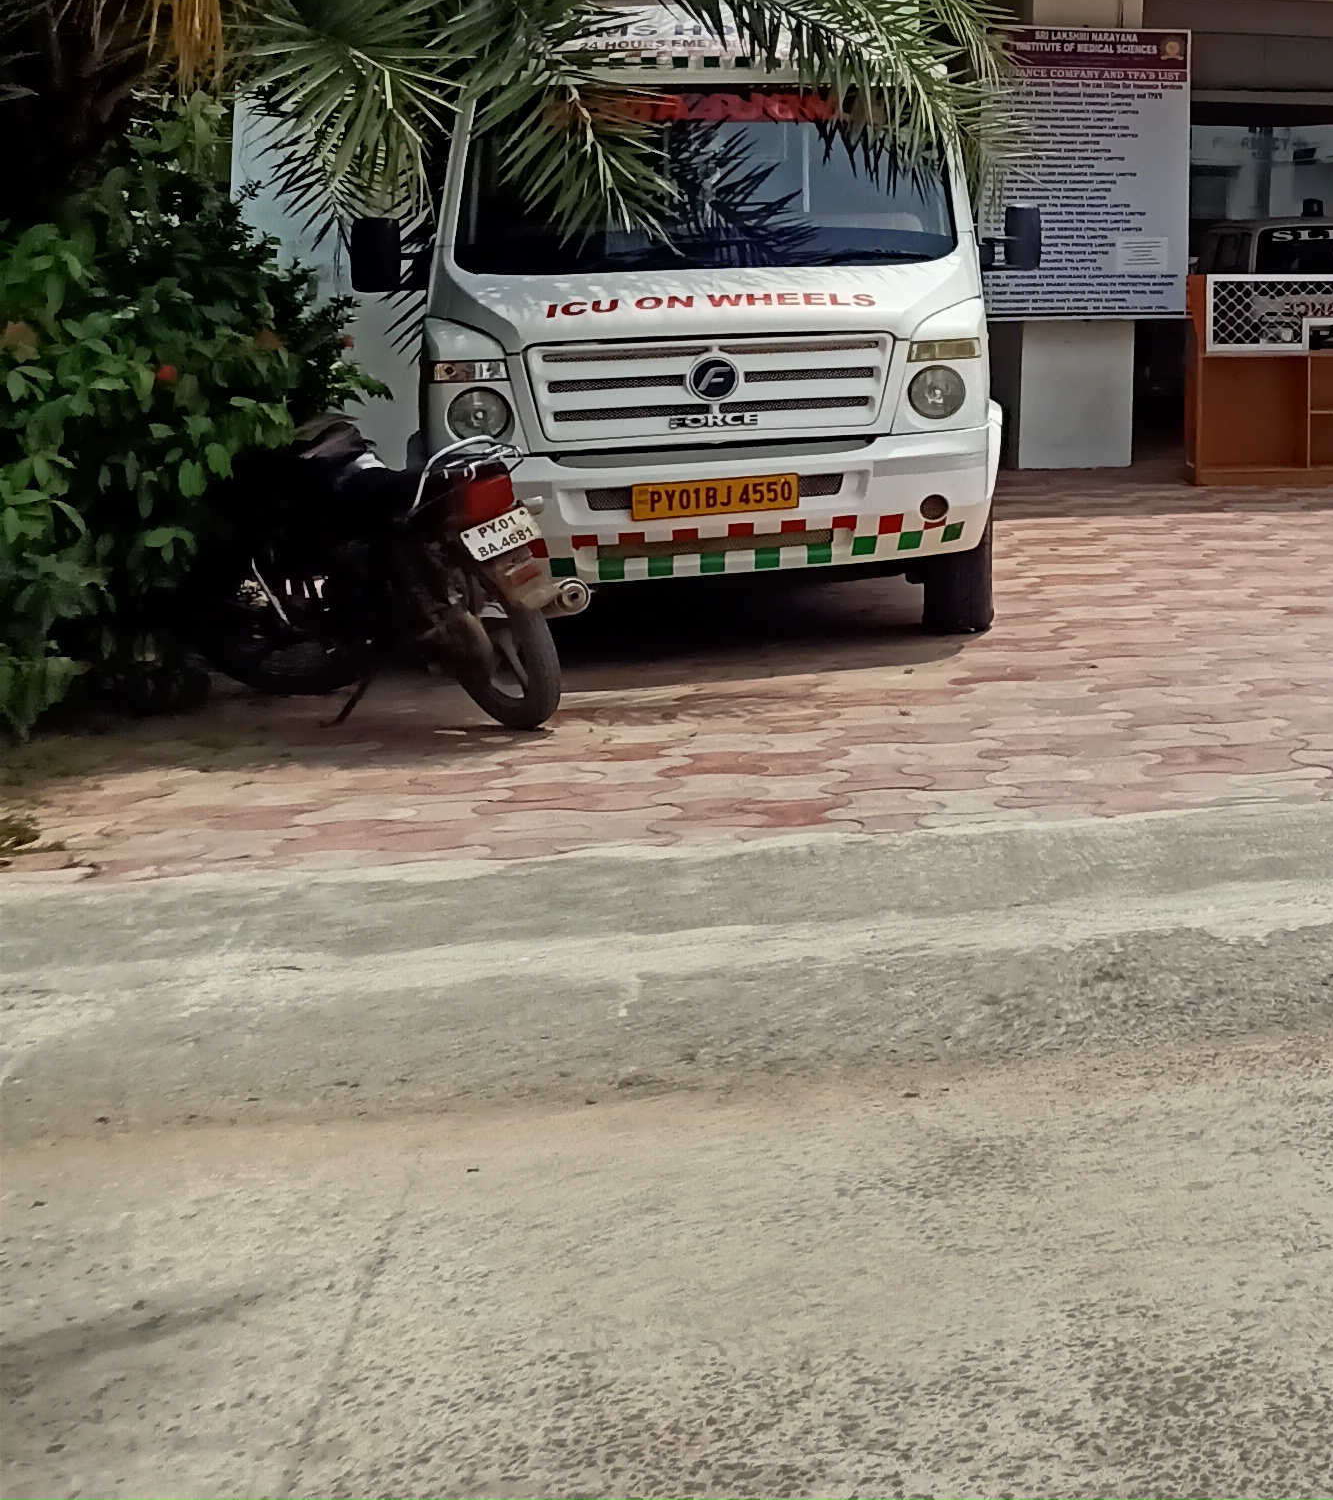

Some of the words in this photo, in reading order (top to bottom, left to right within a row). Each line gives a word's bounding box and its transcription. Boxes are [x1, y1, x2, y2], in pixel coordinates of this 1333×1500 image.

[1050, 69, 1100, 79] COMPANY
[1102, 70, 1126, 79] AND
[546, 299, 621, 319] ICU
[636, 294, 694, 311] ON
[707, 292, 877, 309] WHEELS
[669, 411, 760, 429] FORCE
[648, 484, 735, 513] PY01BJ
[738, 479, 792, 504] 4550
[477, 514, 517, 539] PY.01
